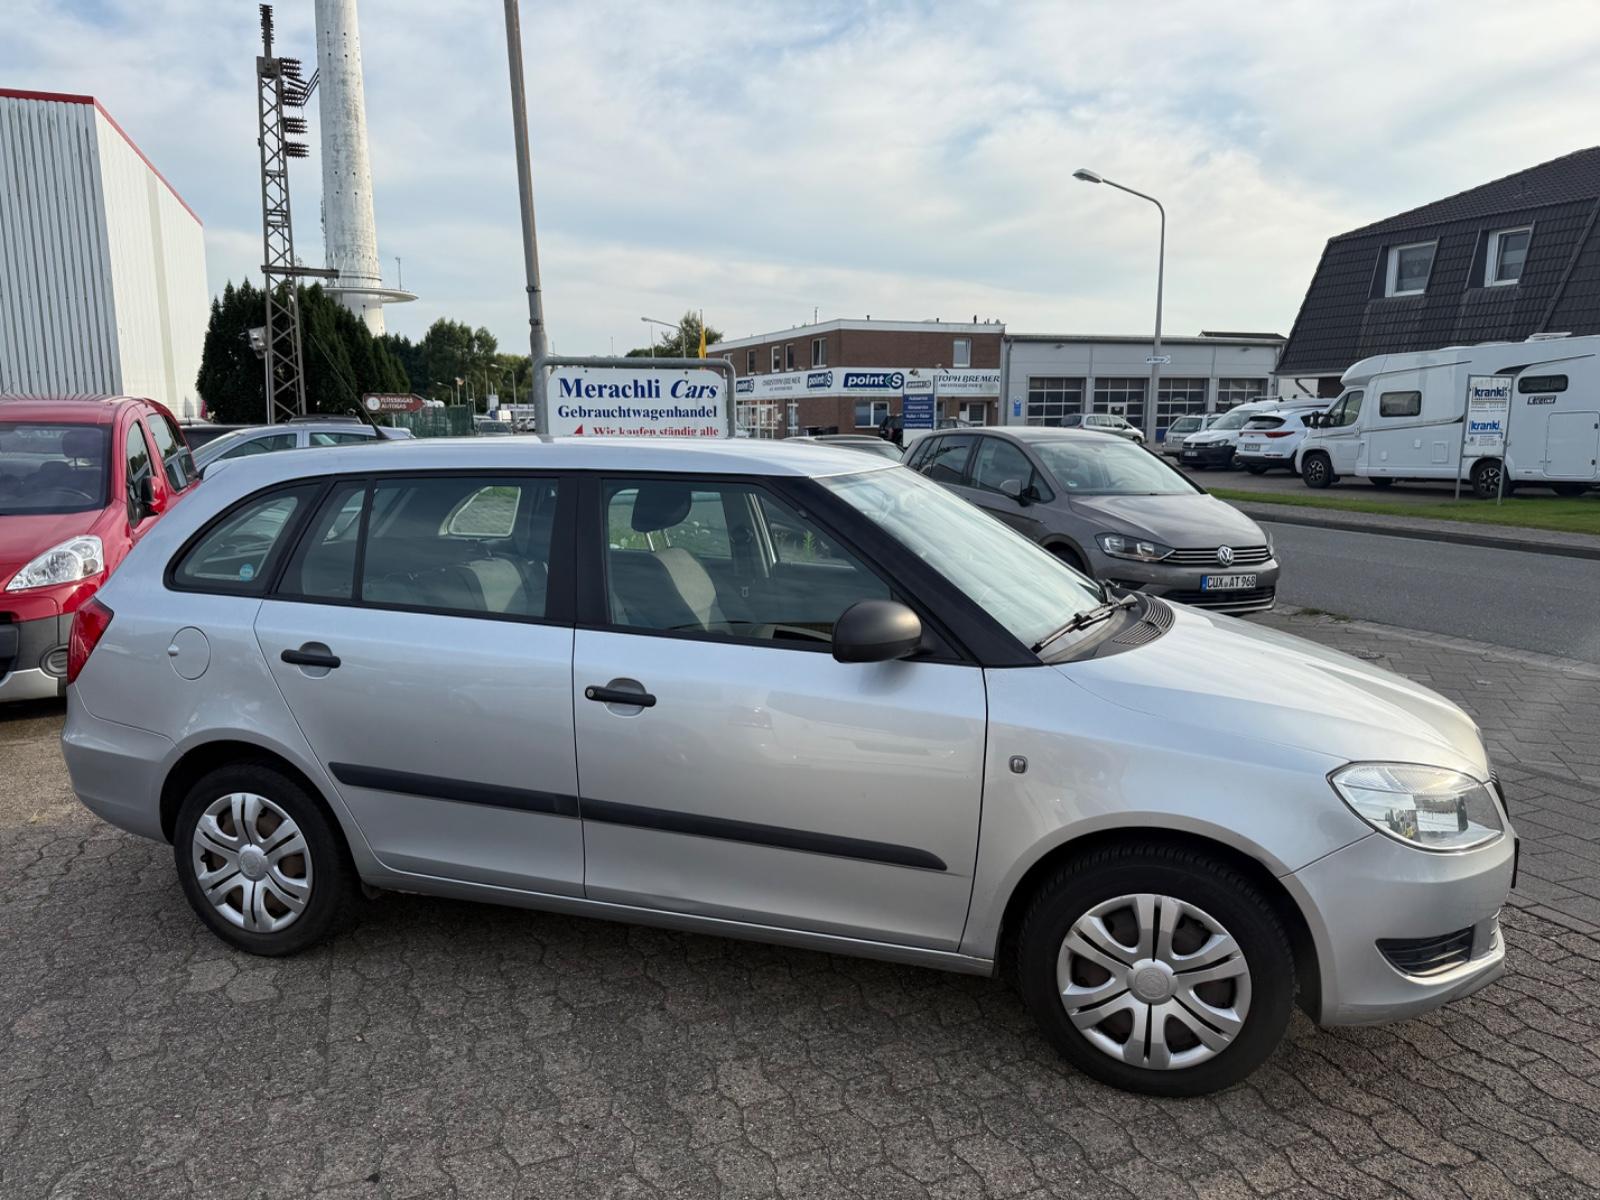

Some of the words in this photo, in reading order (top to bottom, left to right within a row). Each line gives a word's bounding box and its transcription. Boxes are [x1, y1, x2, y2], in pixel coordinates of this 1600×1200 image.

[808, 375, 825, 385] point
[848, 374, 884, 386] point
[891, 374, 902, 387] S
[559, 378, 660, 399] Merachli
[670, 379, 718, 399] Cars
[558, 405, 717, 420] Gebrauchtwagenhandel
[593, 427, 615, 435] Wir
[619, 427, 656, 436] kaufen
[660, 426, 697, 437] ständig
[700, 427, 719, 437] alle
[1207, 576, 1224, 588] CUX
[1229, 576, 1240, 588] AT
[1242, 576, 1256, 588] 968
